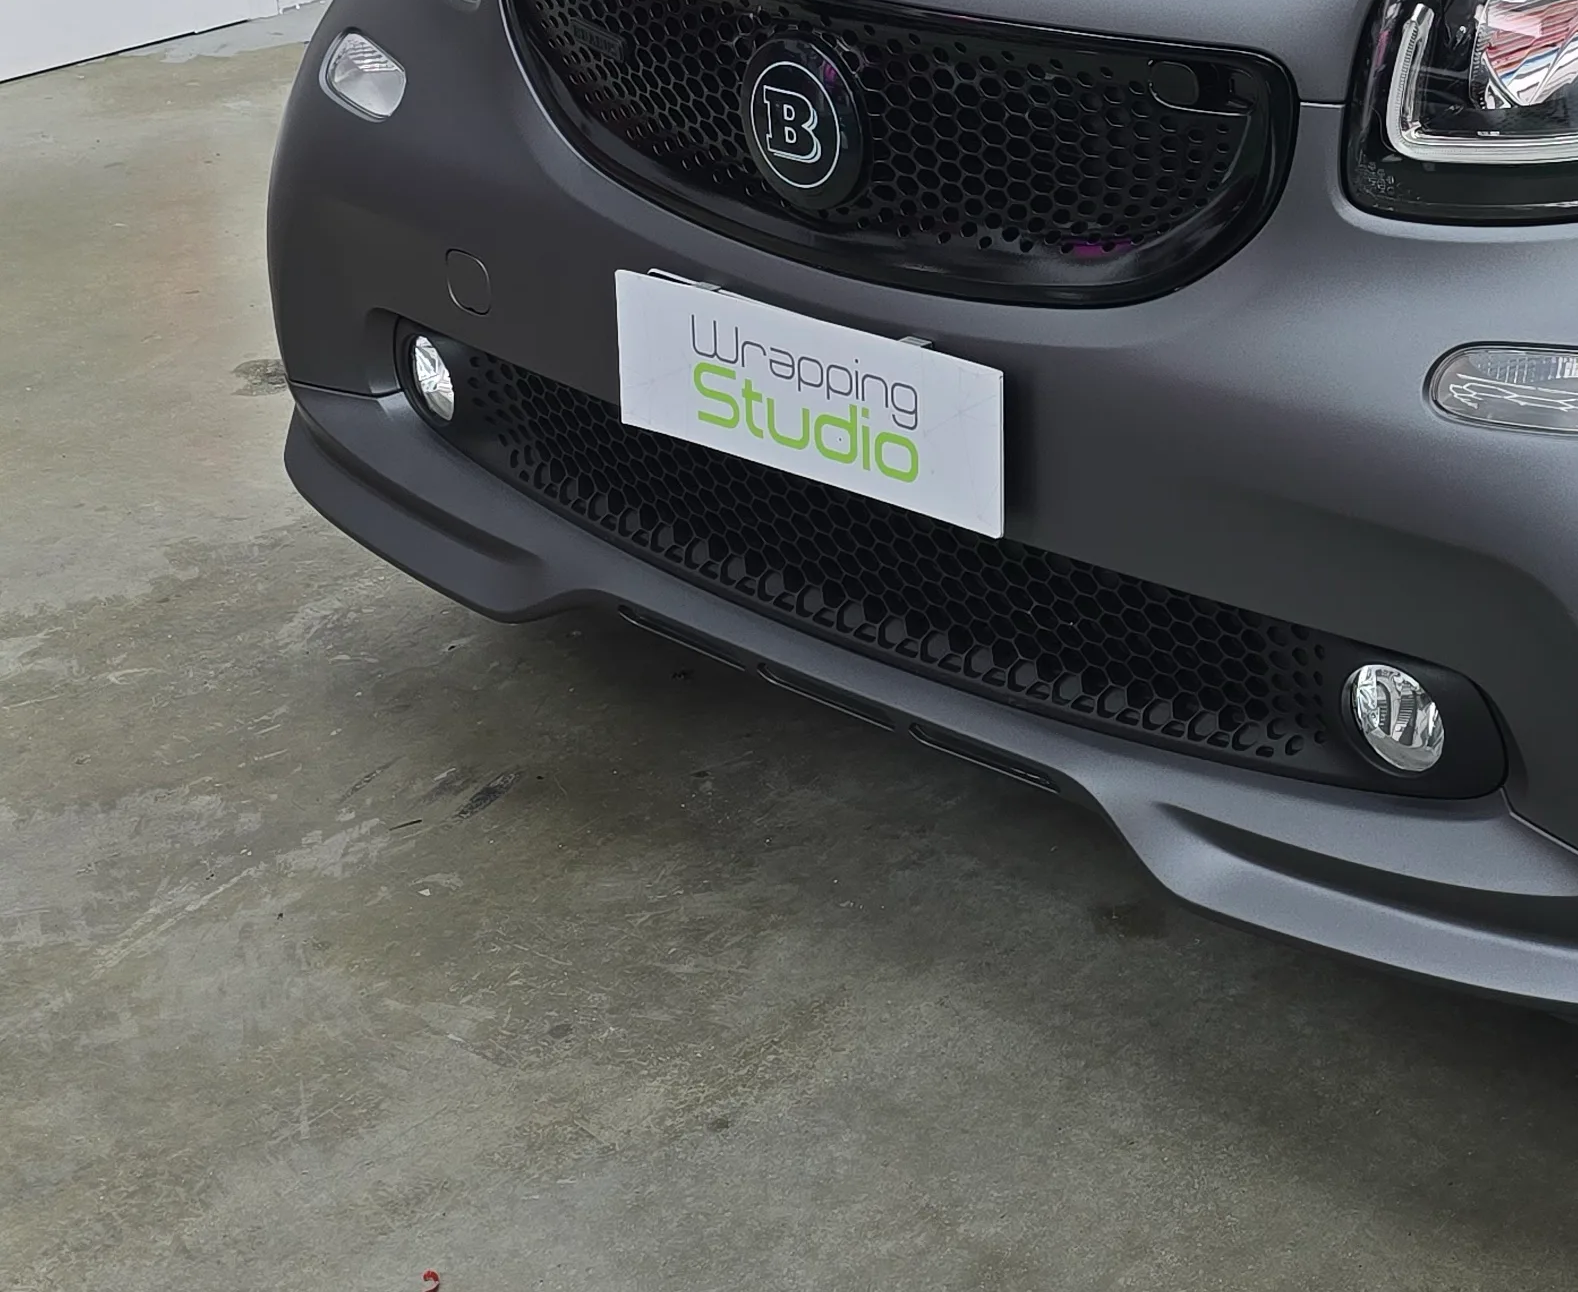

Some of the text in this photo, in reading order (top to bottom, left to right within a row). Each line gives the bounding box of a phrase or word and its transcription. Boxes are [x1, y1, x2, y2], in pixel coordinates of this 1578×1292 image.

[763, 85, 822, 163] B
[690, 313, 918, 430] Wrapping
[693, 362, 919, 484] Studio
